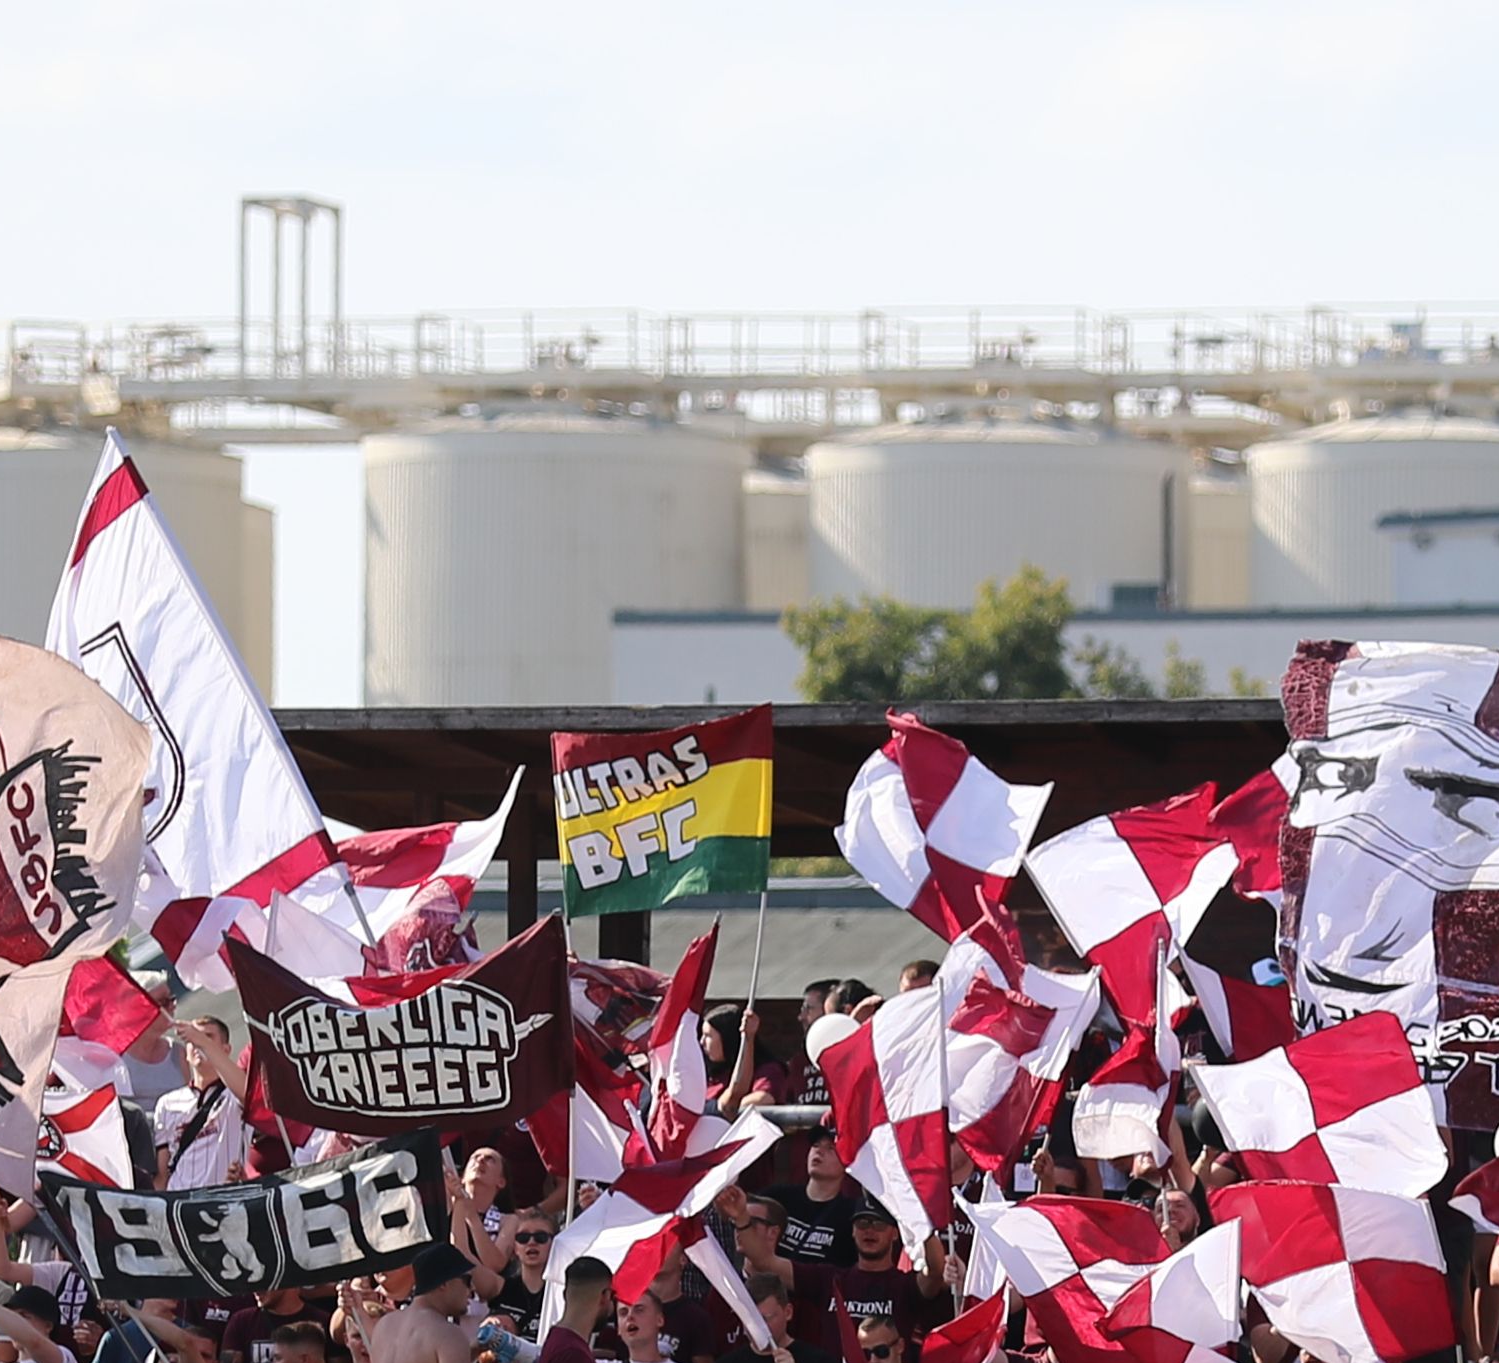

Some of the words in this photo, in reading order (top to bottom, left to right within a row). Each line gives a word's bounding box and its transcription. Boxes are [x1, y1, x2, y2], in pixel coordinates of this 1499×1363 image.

[553, 734, 709, 820] ULTRAS
[567, 797, 697, 890] BFC
[285, 984, 510, 1054] OBERLIGA
[303, 1047, 502, 1107] KRIEEEG
